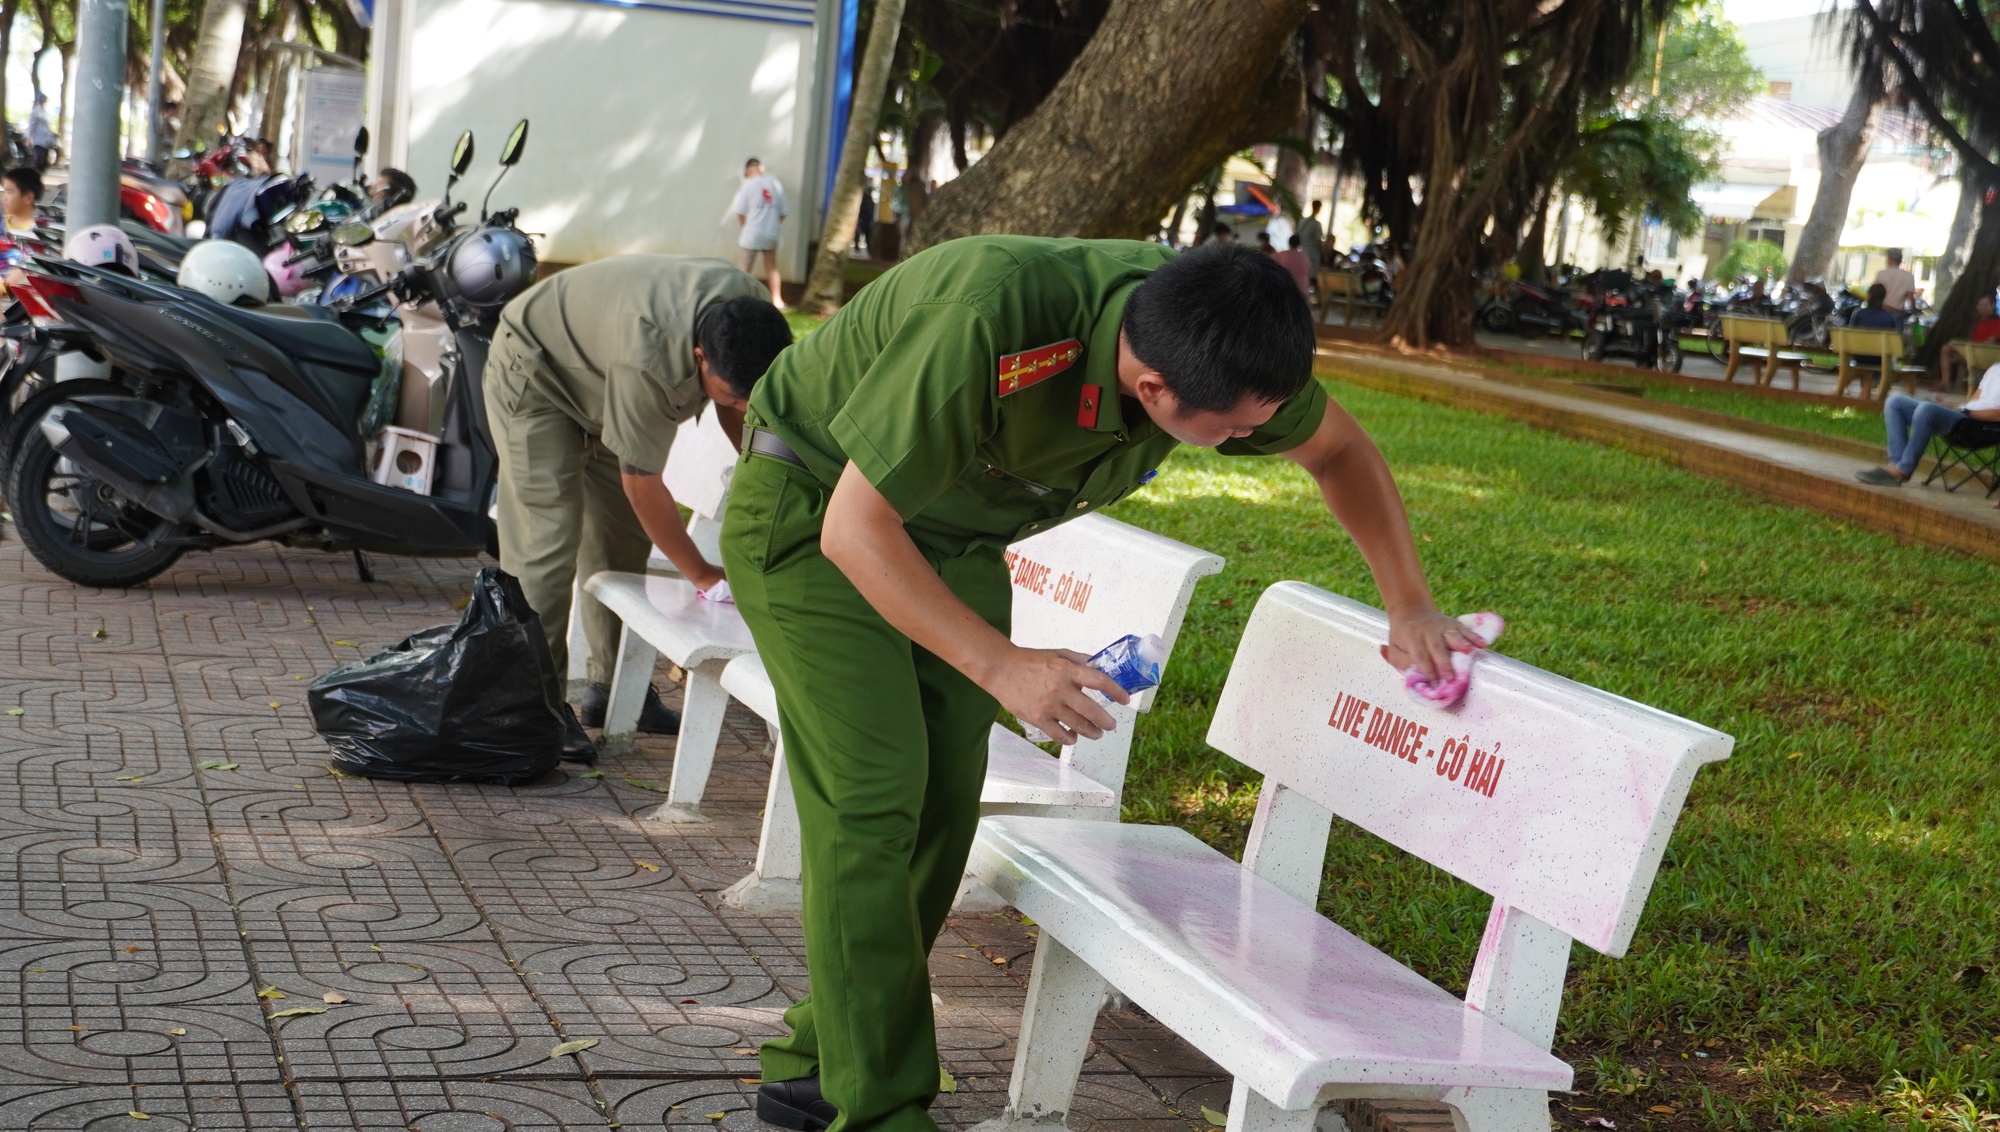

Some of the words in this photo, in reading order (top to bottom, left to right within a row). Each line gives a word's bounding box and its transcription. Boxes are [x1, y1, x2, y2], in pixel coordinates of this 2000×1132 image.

[1004, 550, 1019, 570] IVE
[1014, 557, 1052, 595] DANCE
[1053, 571, 1075, 605] CÔ
[1068, 573, 1093, 613] HẢI
[1328, 691, 1370, 738] LIVE
[1363, 706, 1429, 765] DANCE
[1427, 749, 1435, 758] -
[1436, 735, 1470, 782] CÔ
[1463, 741, 1506, 799] HẢI
